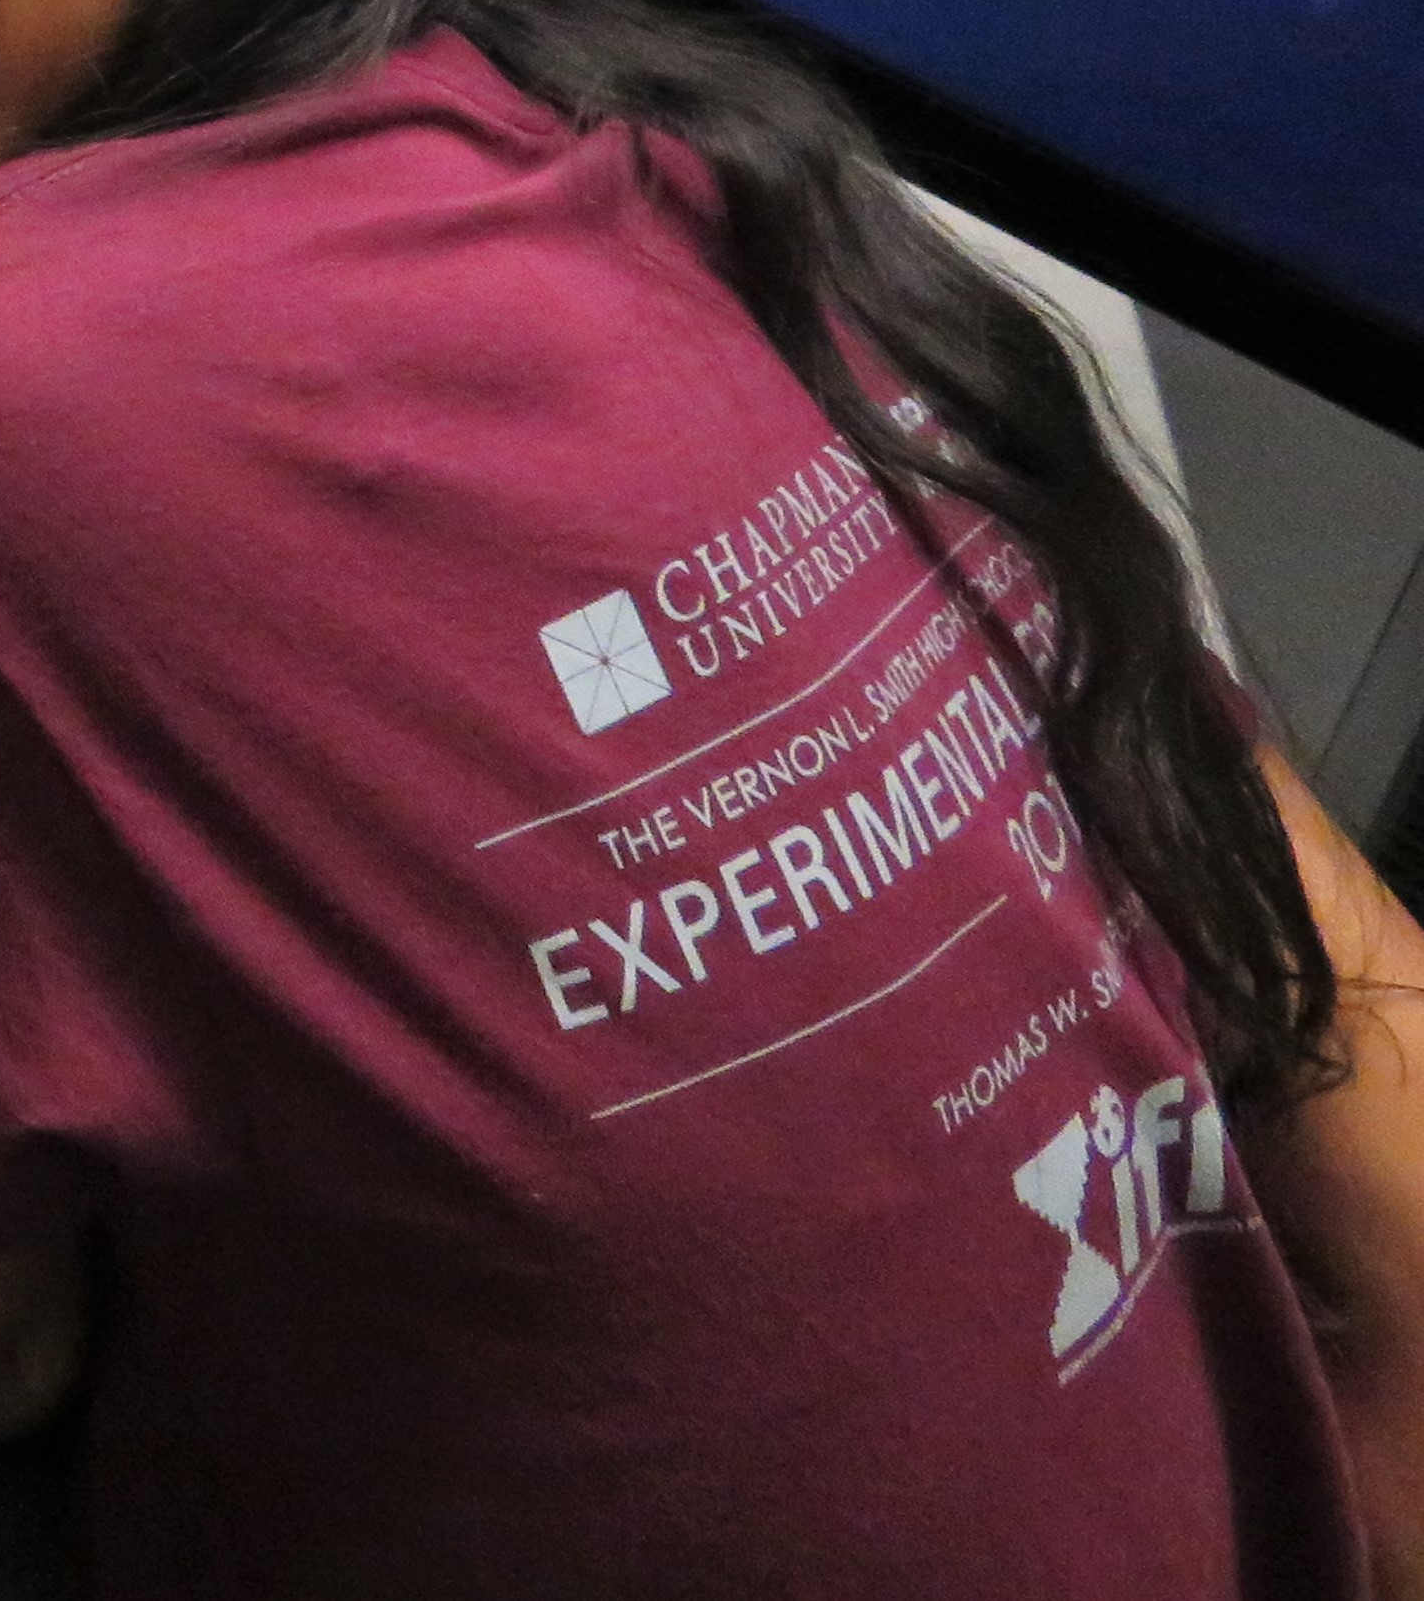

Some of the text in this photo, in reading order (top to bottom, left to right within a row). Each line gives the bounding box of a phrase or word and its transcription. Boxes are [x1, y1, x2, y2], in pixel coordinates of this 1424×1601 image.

[654, 434, 872, 624] CHAPMAN
[676, 492, 899, 679] UNIVERSITY
[598, 805, 688, 870] THE
[681, 713, 853, 829] VERNON
[841, 705, 878, 744] L.
[864, 644, 924, 724] SMITH
[919, 599, 970, 670] HIGH
[528, 655, 1041, 1032] EXPERIMENTAL
[932, 987, 1090, 1135] THOMAS W.
